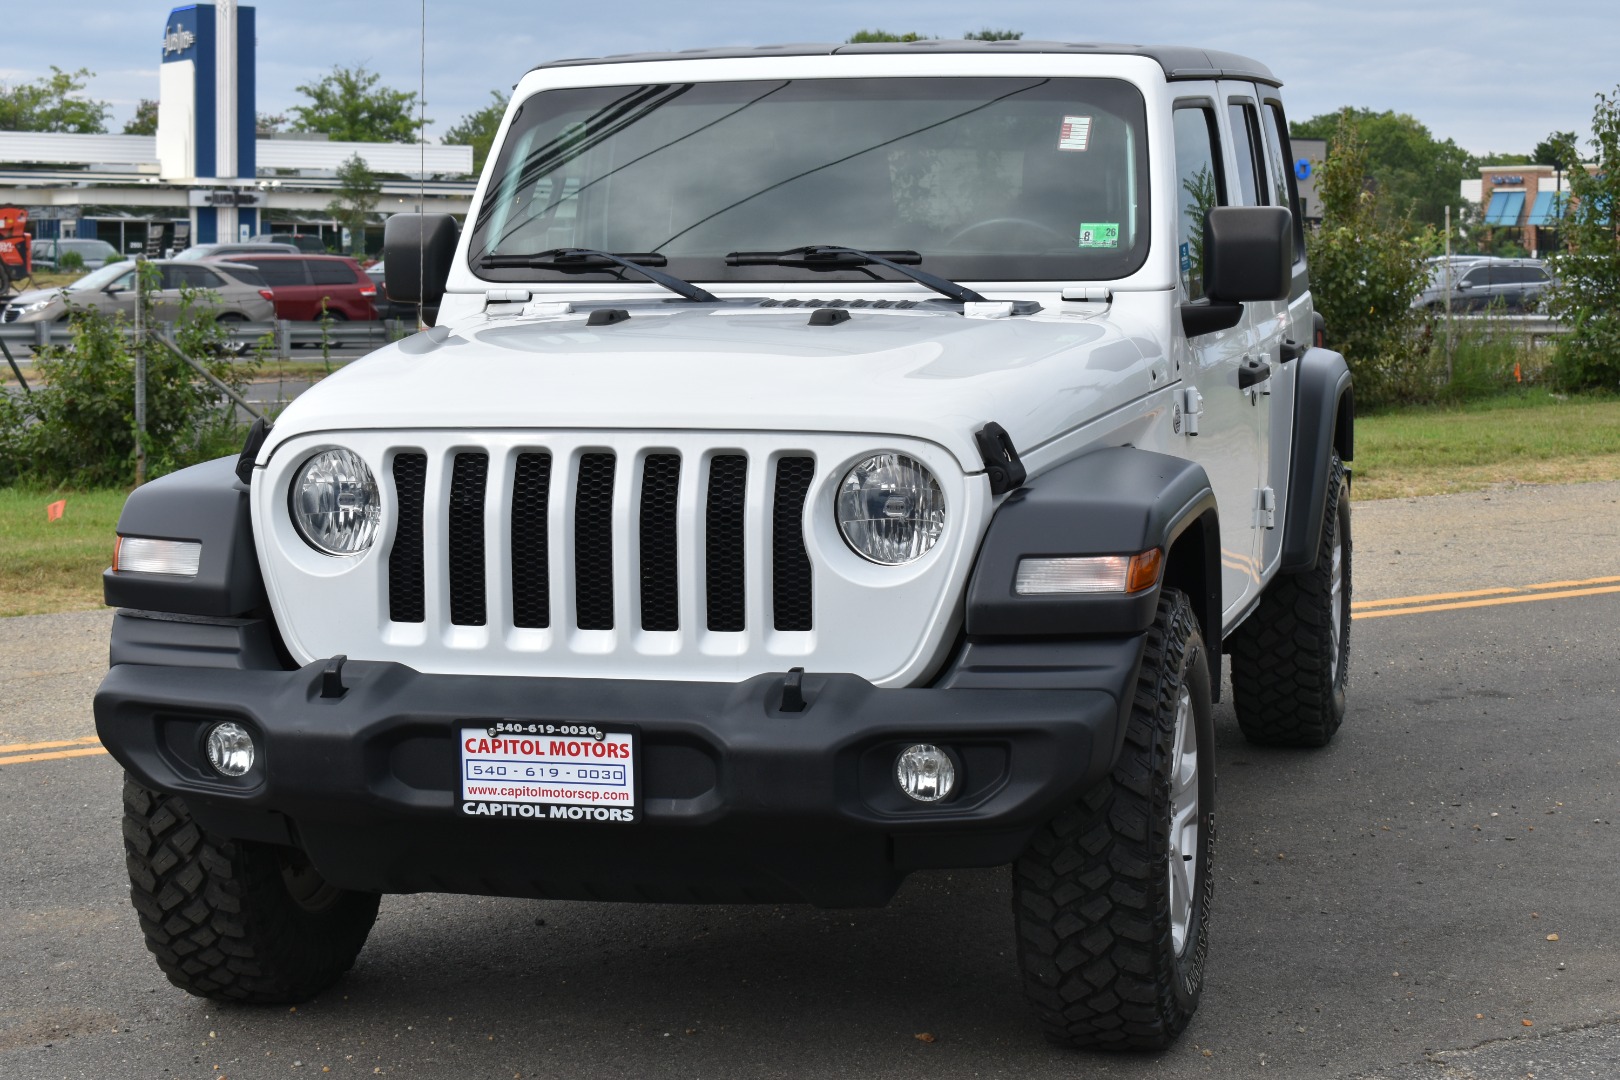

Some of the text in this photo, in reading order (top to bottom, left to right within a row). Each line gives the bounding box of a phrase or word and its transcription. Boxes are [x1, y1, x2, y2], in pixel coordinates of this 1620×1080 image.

[1083, 230, 1091, 241] 8
[1105, 227, 1116, 237] 26
[496, 723, 597, 735] 540-619-0030
[465, 738, 630, 759] CAPITOL MOTORS
[473, 765, 507, 776] 540
[525, 767, 559, 777] 619
[577, 769, 623, 780] 0030
[467, 786, 629, 802] www.capitolmotorscp.com
[462, 802, 634, 822] CAPITOL MOTORS
